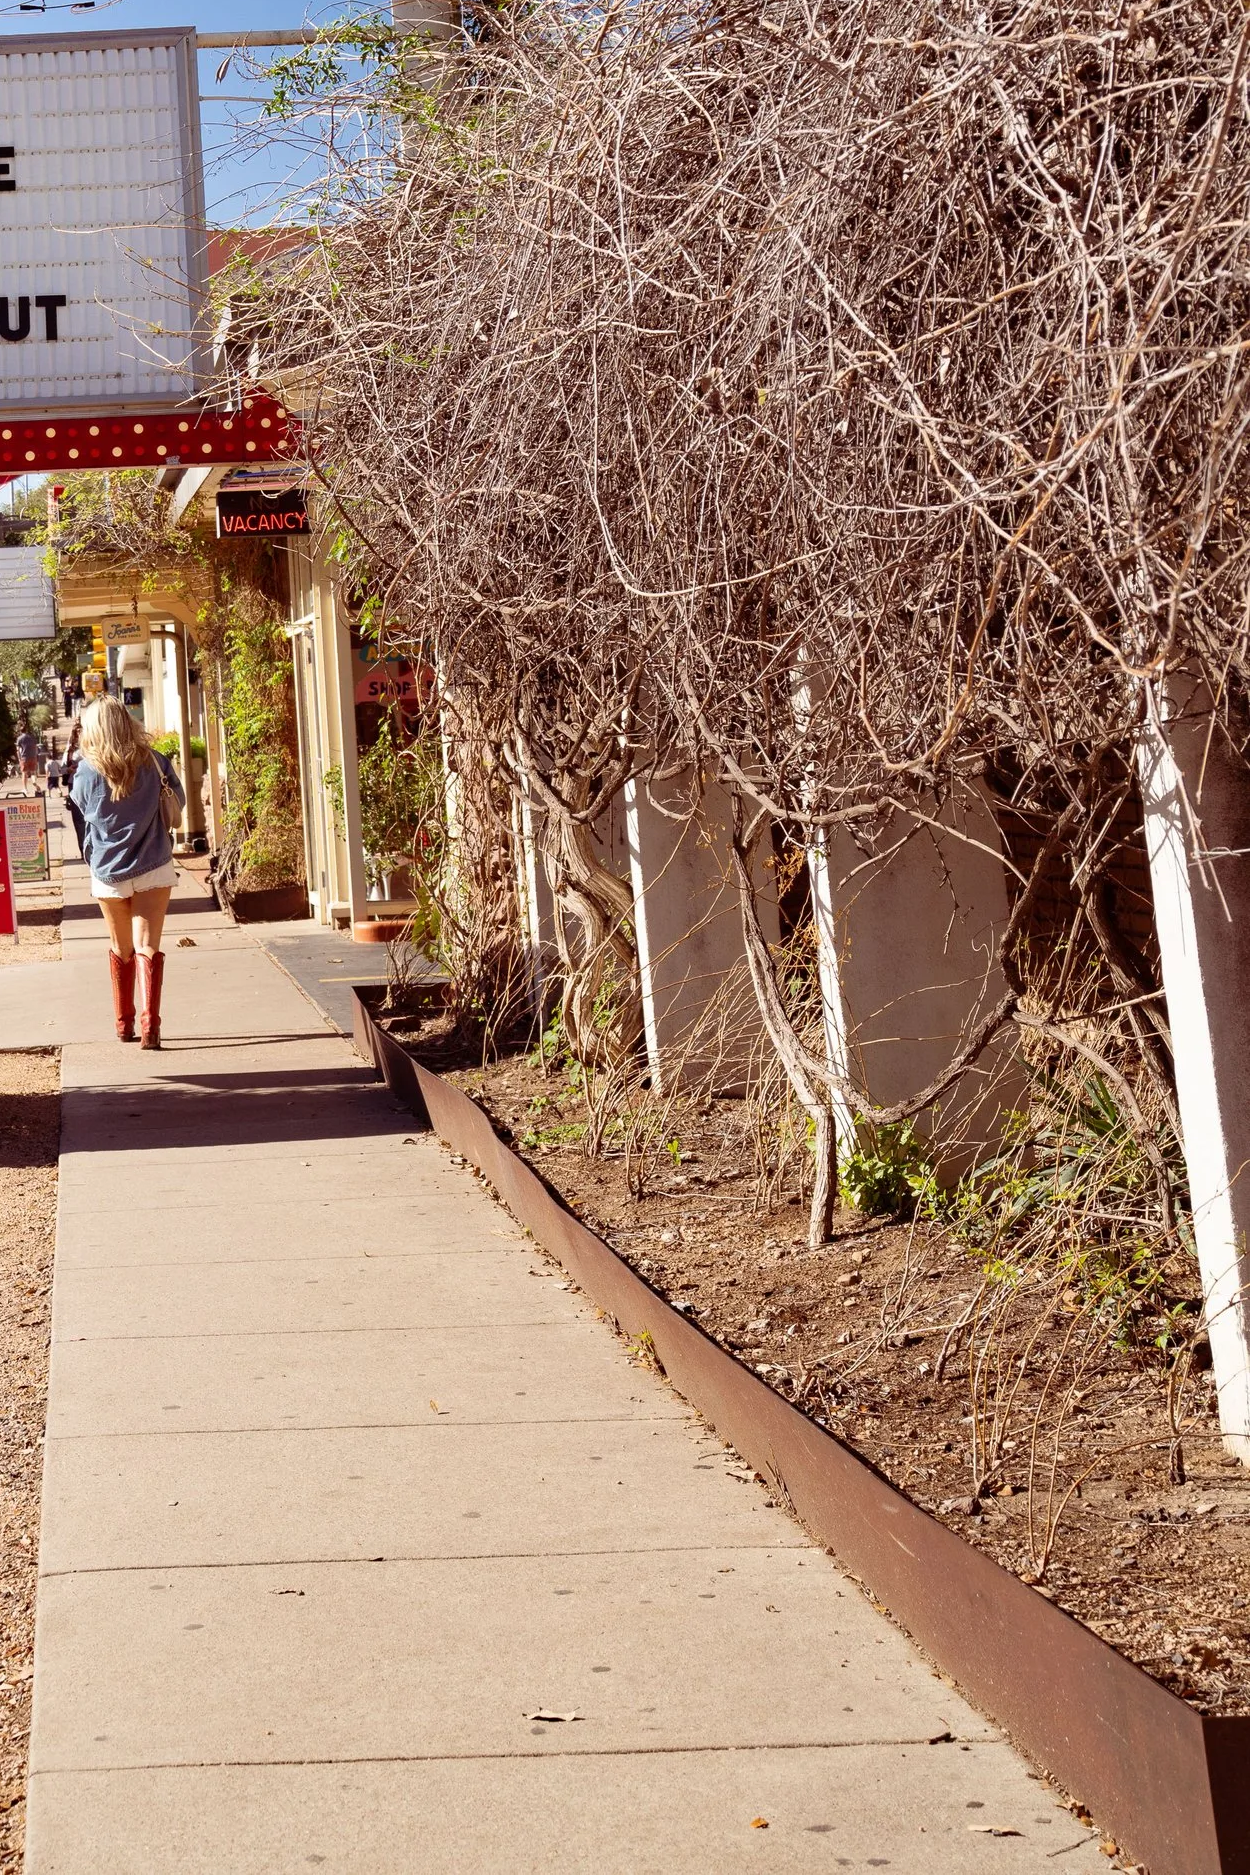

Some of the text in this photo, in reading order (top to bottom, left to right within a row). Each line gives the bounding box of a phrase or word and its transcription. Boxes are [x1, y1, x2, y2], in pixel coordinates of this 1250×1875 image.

[222, 511, 307, 533] VACANCY
[368, 680, 411, 696] SHOP
[19, 804, 41, 814] Blues
